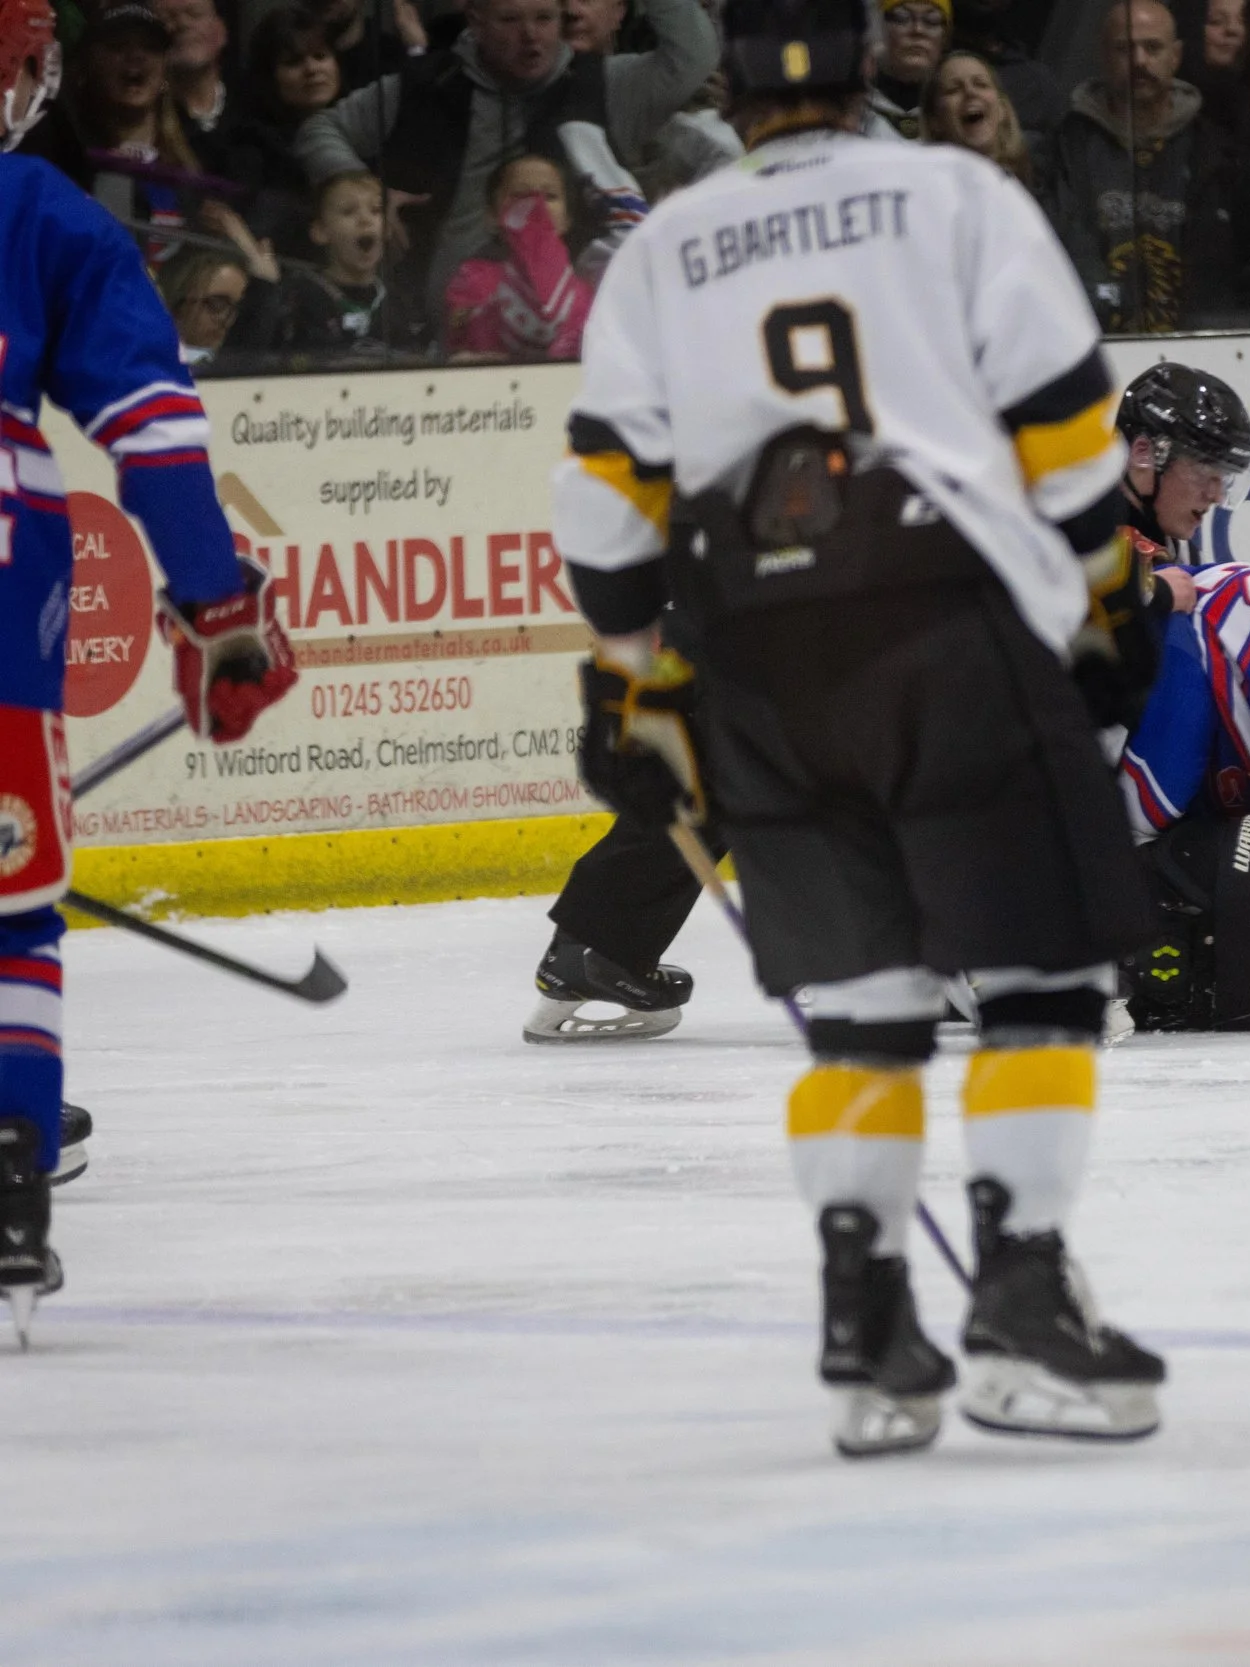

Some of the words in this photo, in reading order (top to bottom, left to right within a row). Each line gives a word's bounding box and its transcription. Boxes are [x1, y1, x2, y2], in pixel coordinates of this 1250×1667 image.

[679, 189, 910, 289] G.BARTLETT
[761, 296, 873, 439] 9
[231, 411, 321, 449] Quality
[325, 405, 415, 446] building
[420, 398, 537, 435] materials
[320, 468, 418, 515] supplied
[424, 465, 452, 506] by
[72, 532, 111, 561] CAL
[68, 584, 110, 613] REA
[232, 532, 578, 630] HANDLER
[311, 682, 383, 720] 01245
[389, 676, 473, 716] 352650
[186, 752, 207, 779] 91
[213, 746, 301, 777] Widford
[307, 737, 371, 773] Road,
[376, 733, 506, 768] Chelmsford,
[513, 729, 560, 758] CM2
[104, 805, 208, 834] MATERIALS
[223, 795, 353, 826] LANDSCAPING
[367, 786, 468, 816] BATHROOM
[473, 778, 580, 808] SHOWROOM
